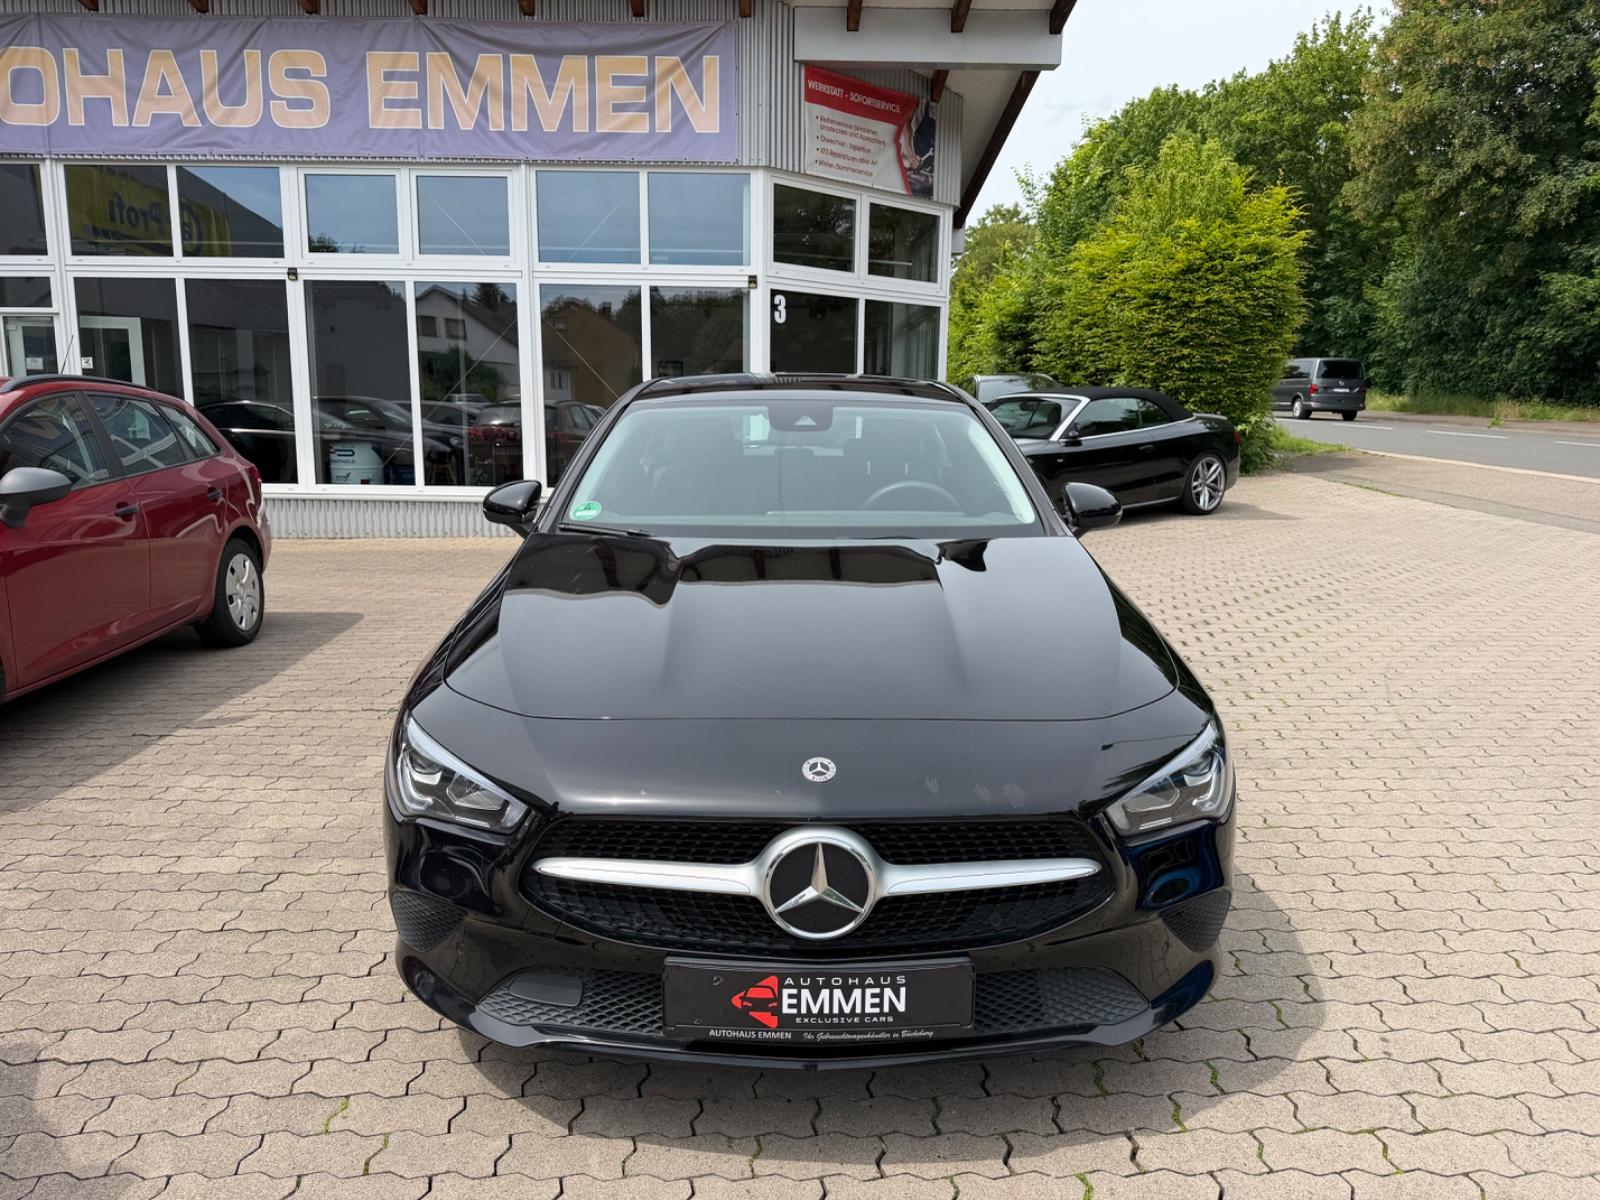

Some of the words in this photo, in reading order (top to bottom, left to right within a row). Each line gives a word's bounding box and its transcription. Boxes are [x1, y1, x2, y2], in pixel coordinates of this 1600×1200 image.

[0, 46, 331, 129] OHAUS
[366, 50, 720, 133] EMMEN
[808, 79, 844, 98] WERKSTATT
[774, 294, 786, 324] 3
[784, 975, 907, 986] AUTOHAUS
[781, 986, 907, 1015] EMMEN
[795, 1016, 861, 1024] EXCLUSIVE
[864, 1015, 894, 1023] CARS
[708, 1029, 756, 1039] AUTOHAUS
[757, 1031, 792, 1040] EMMEN
